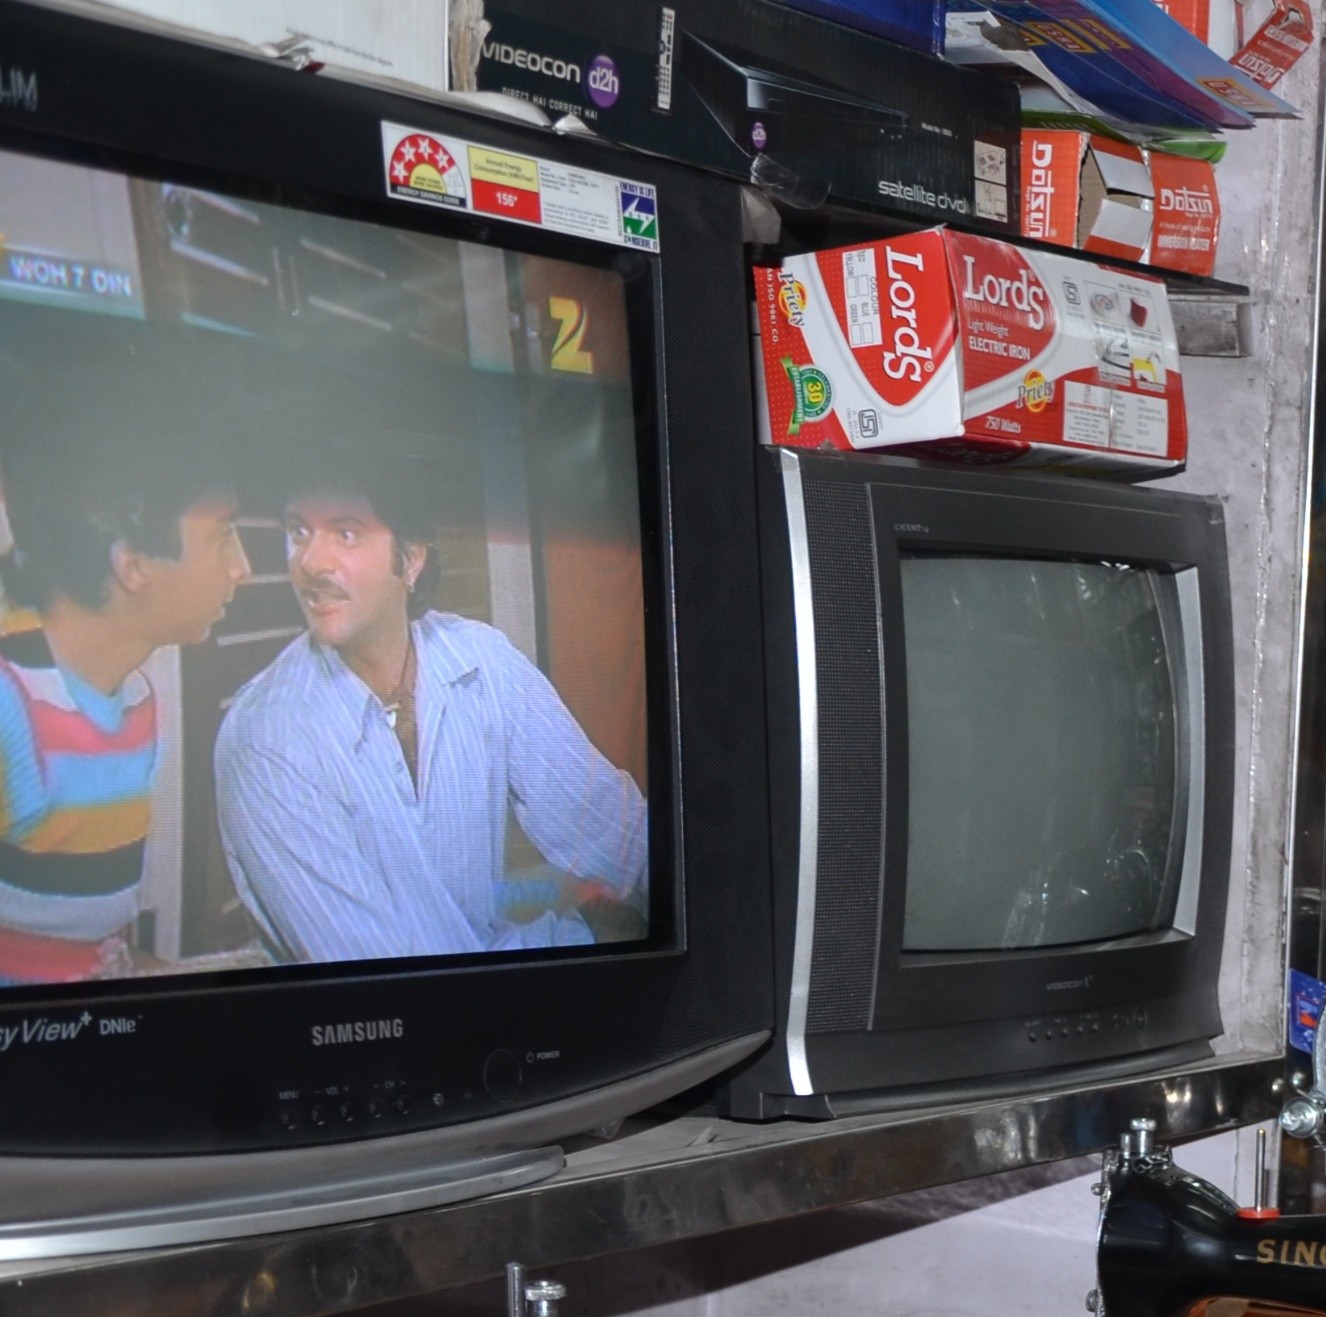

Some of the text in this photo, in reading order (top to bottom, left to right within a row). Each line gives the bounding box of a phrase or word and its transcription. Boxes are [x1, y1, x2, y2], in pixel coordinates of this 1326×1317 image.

[481, 42, 580, 84] VIDEOCON
[589, 64, 618, 95] d2h
[878, 180, 967, 214] satellite dvd
[10, 255, 67, 288] WOH
[91, 268, 132, 297] DIN
[969, 336, 1031, 361] ELECTRIC IRON
[807, 382, 823, 403] 30
[985, 416, 1002, 430] 750
[312, 1018, 404, 1046] SAMSUNG
[537, 1050, 560, 1061] POWER
